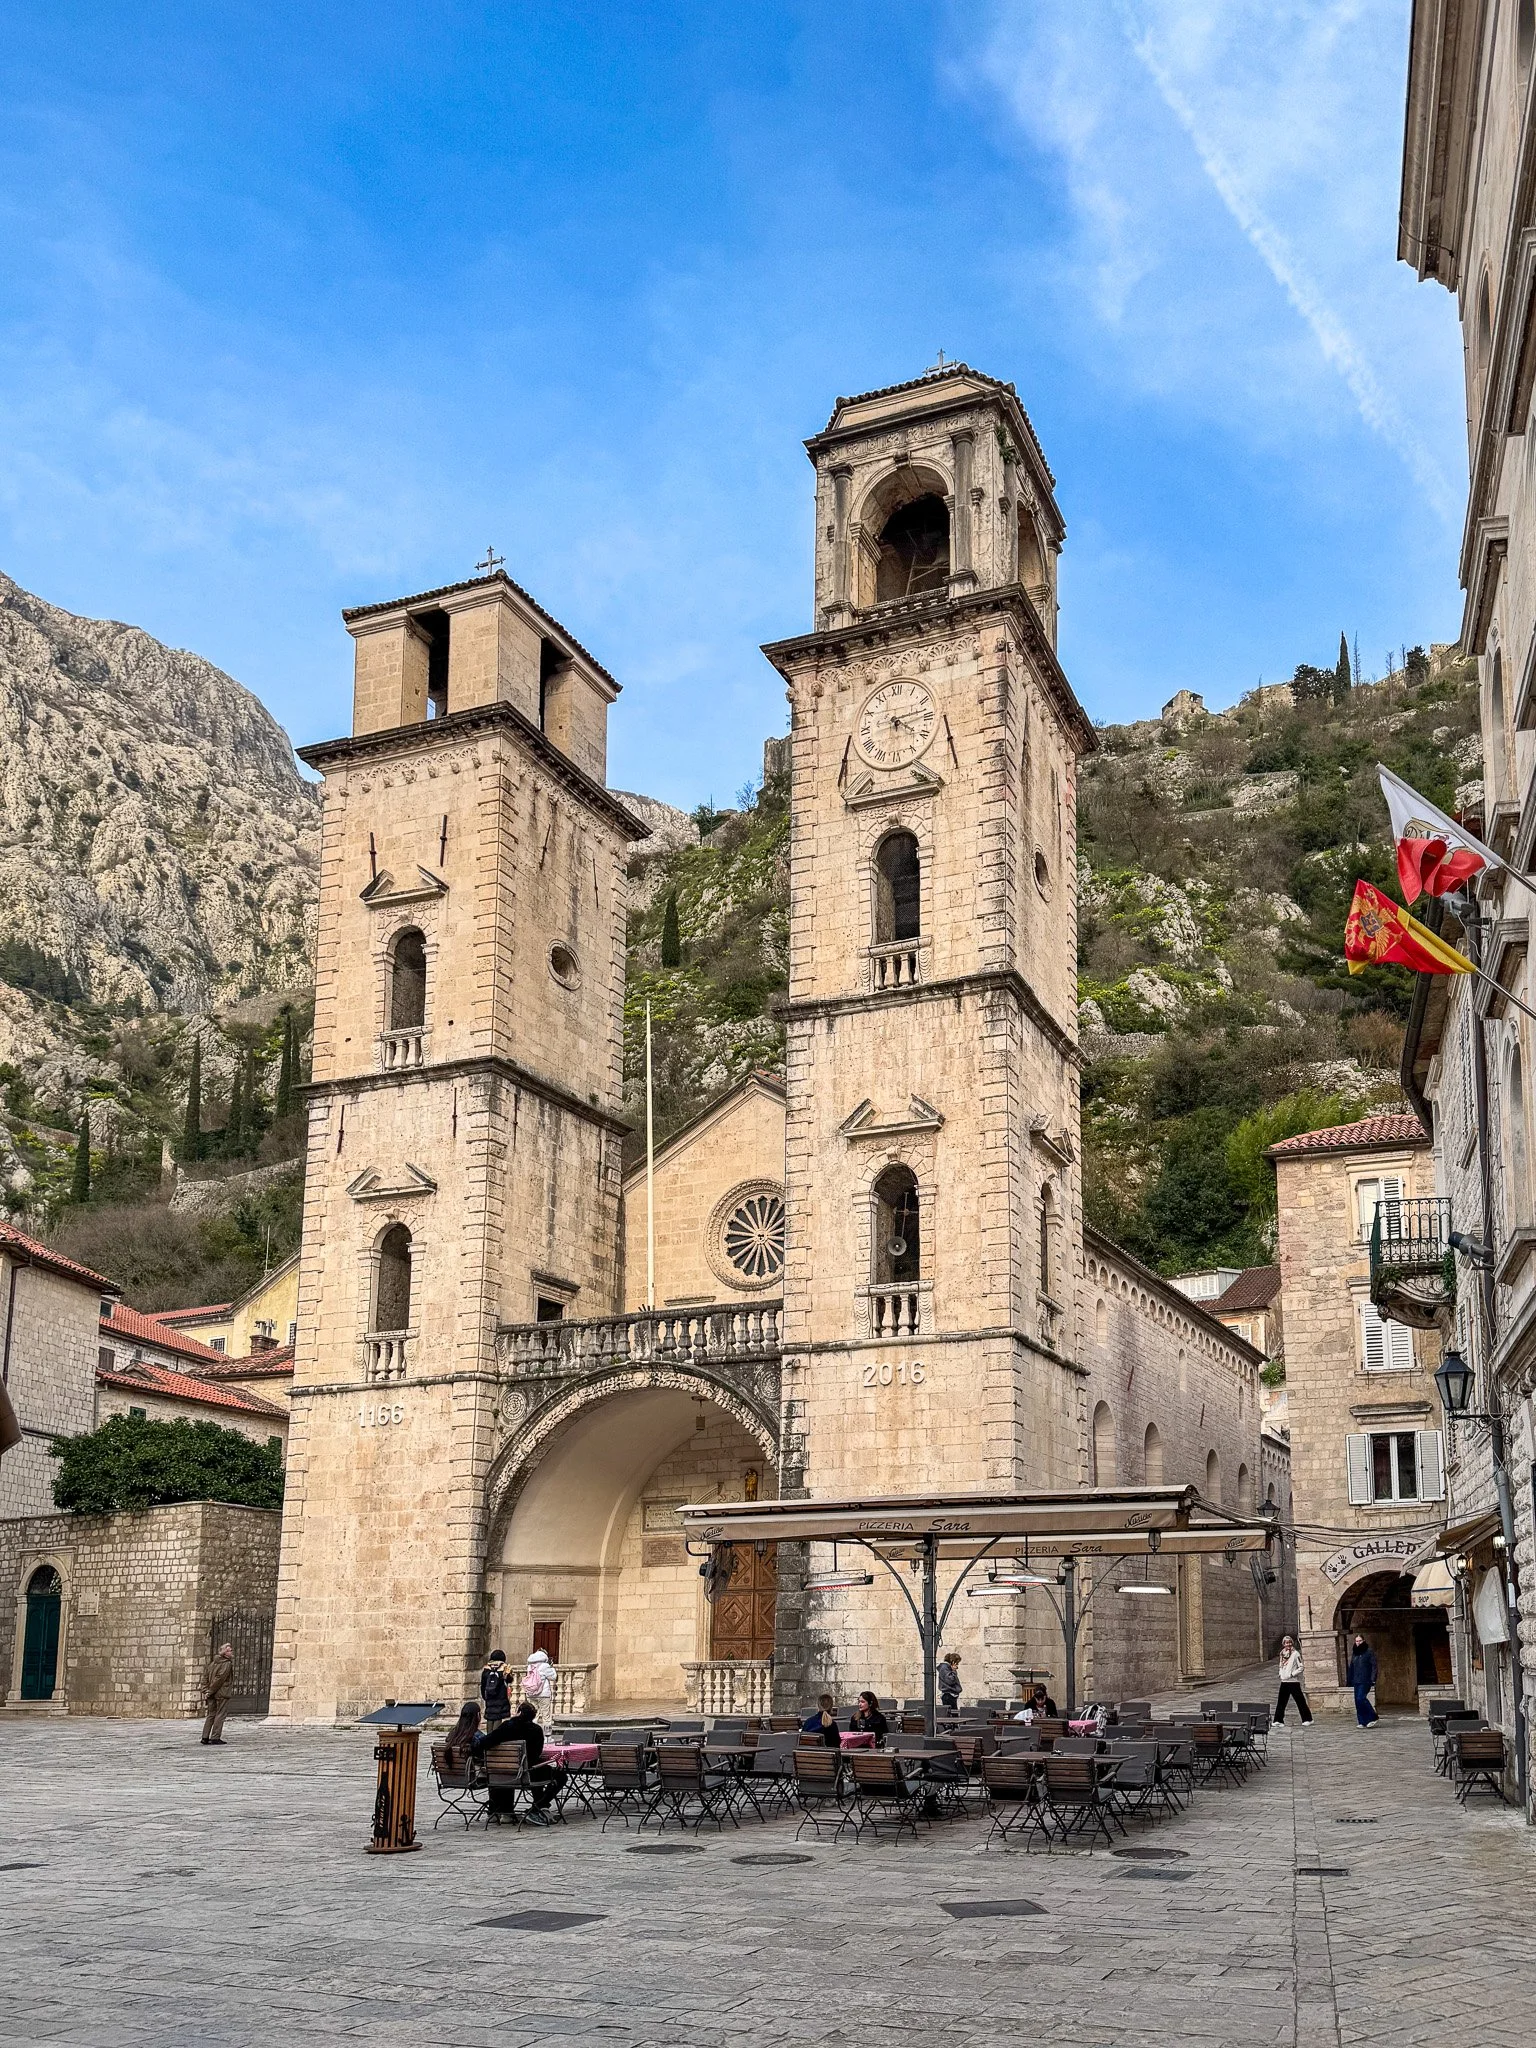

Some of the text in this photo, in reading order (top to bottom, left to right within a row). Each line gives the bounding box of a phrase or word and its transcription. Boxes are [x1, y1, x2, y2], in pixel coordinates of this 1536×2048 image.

[863, 1360, 926, 1388] 2016
[359, 1401, 404, 1429] 1166
[859, 1518, 972, 1532] PIZZERIA Sara
[1069, 1542, 1104, 1554] Sara
[1353, 1540, 1422, 1559] GALLER
